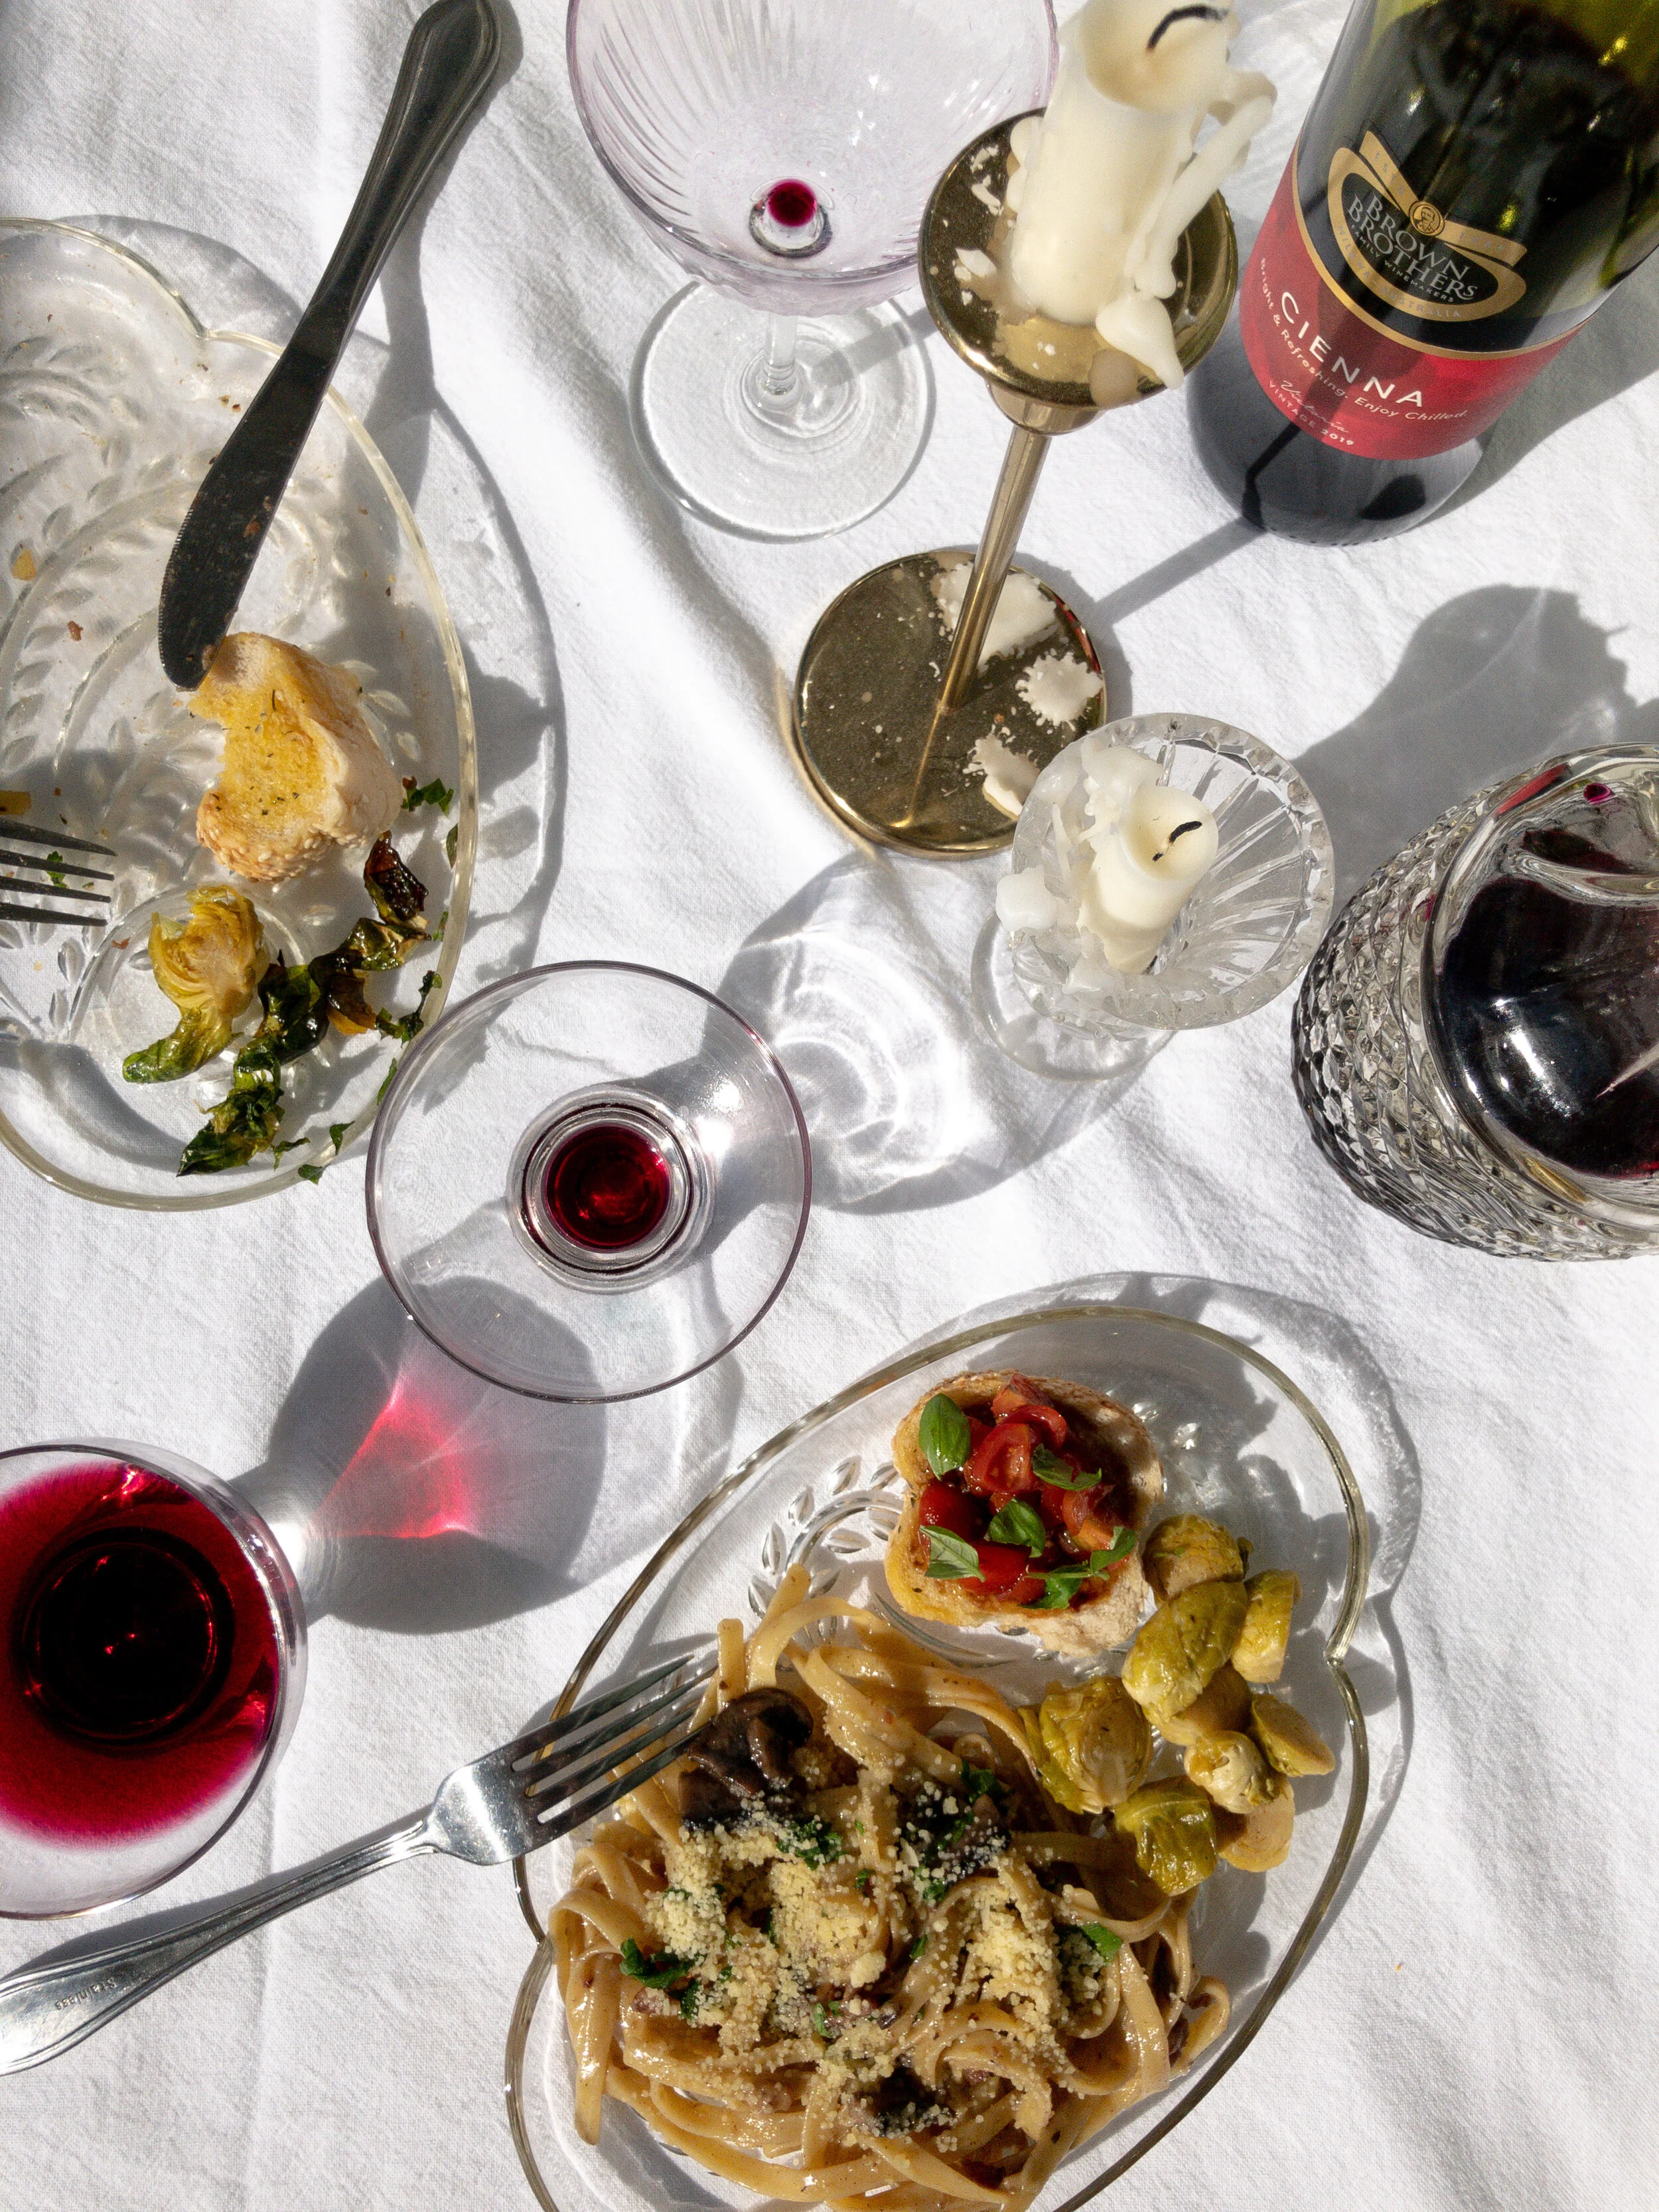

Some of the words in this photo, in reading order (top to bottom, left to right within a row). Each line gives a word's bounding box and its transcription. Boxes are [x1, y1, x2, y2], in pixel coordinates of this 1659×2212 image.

[1348, 193, 1478, 300] BROTHERS
[1351, 224, 1381, 258] FAMILY
[1385, 260, 1455, 302] WINEMAKERS
[1366, 193, 1471, 280] BROWN
[1261, 258, 1274, 310] Bright
[1281, 329, 1349, 399] Refreshing.
[1354, 397, 1400, 417] Enjoy
[1381, 287, 1461, 318] AUSTRALIA
[1281, 292, 1422, 407] CIENNA
[1269, 380, 1317, 428] VINTAGE
[1321, 429, 1354, 445] 2019
